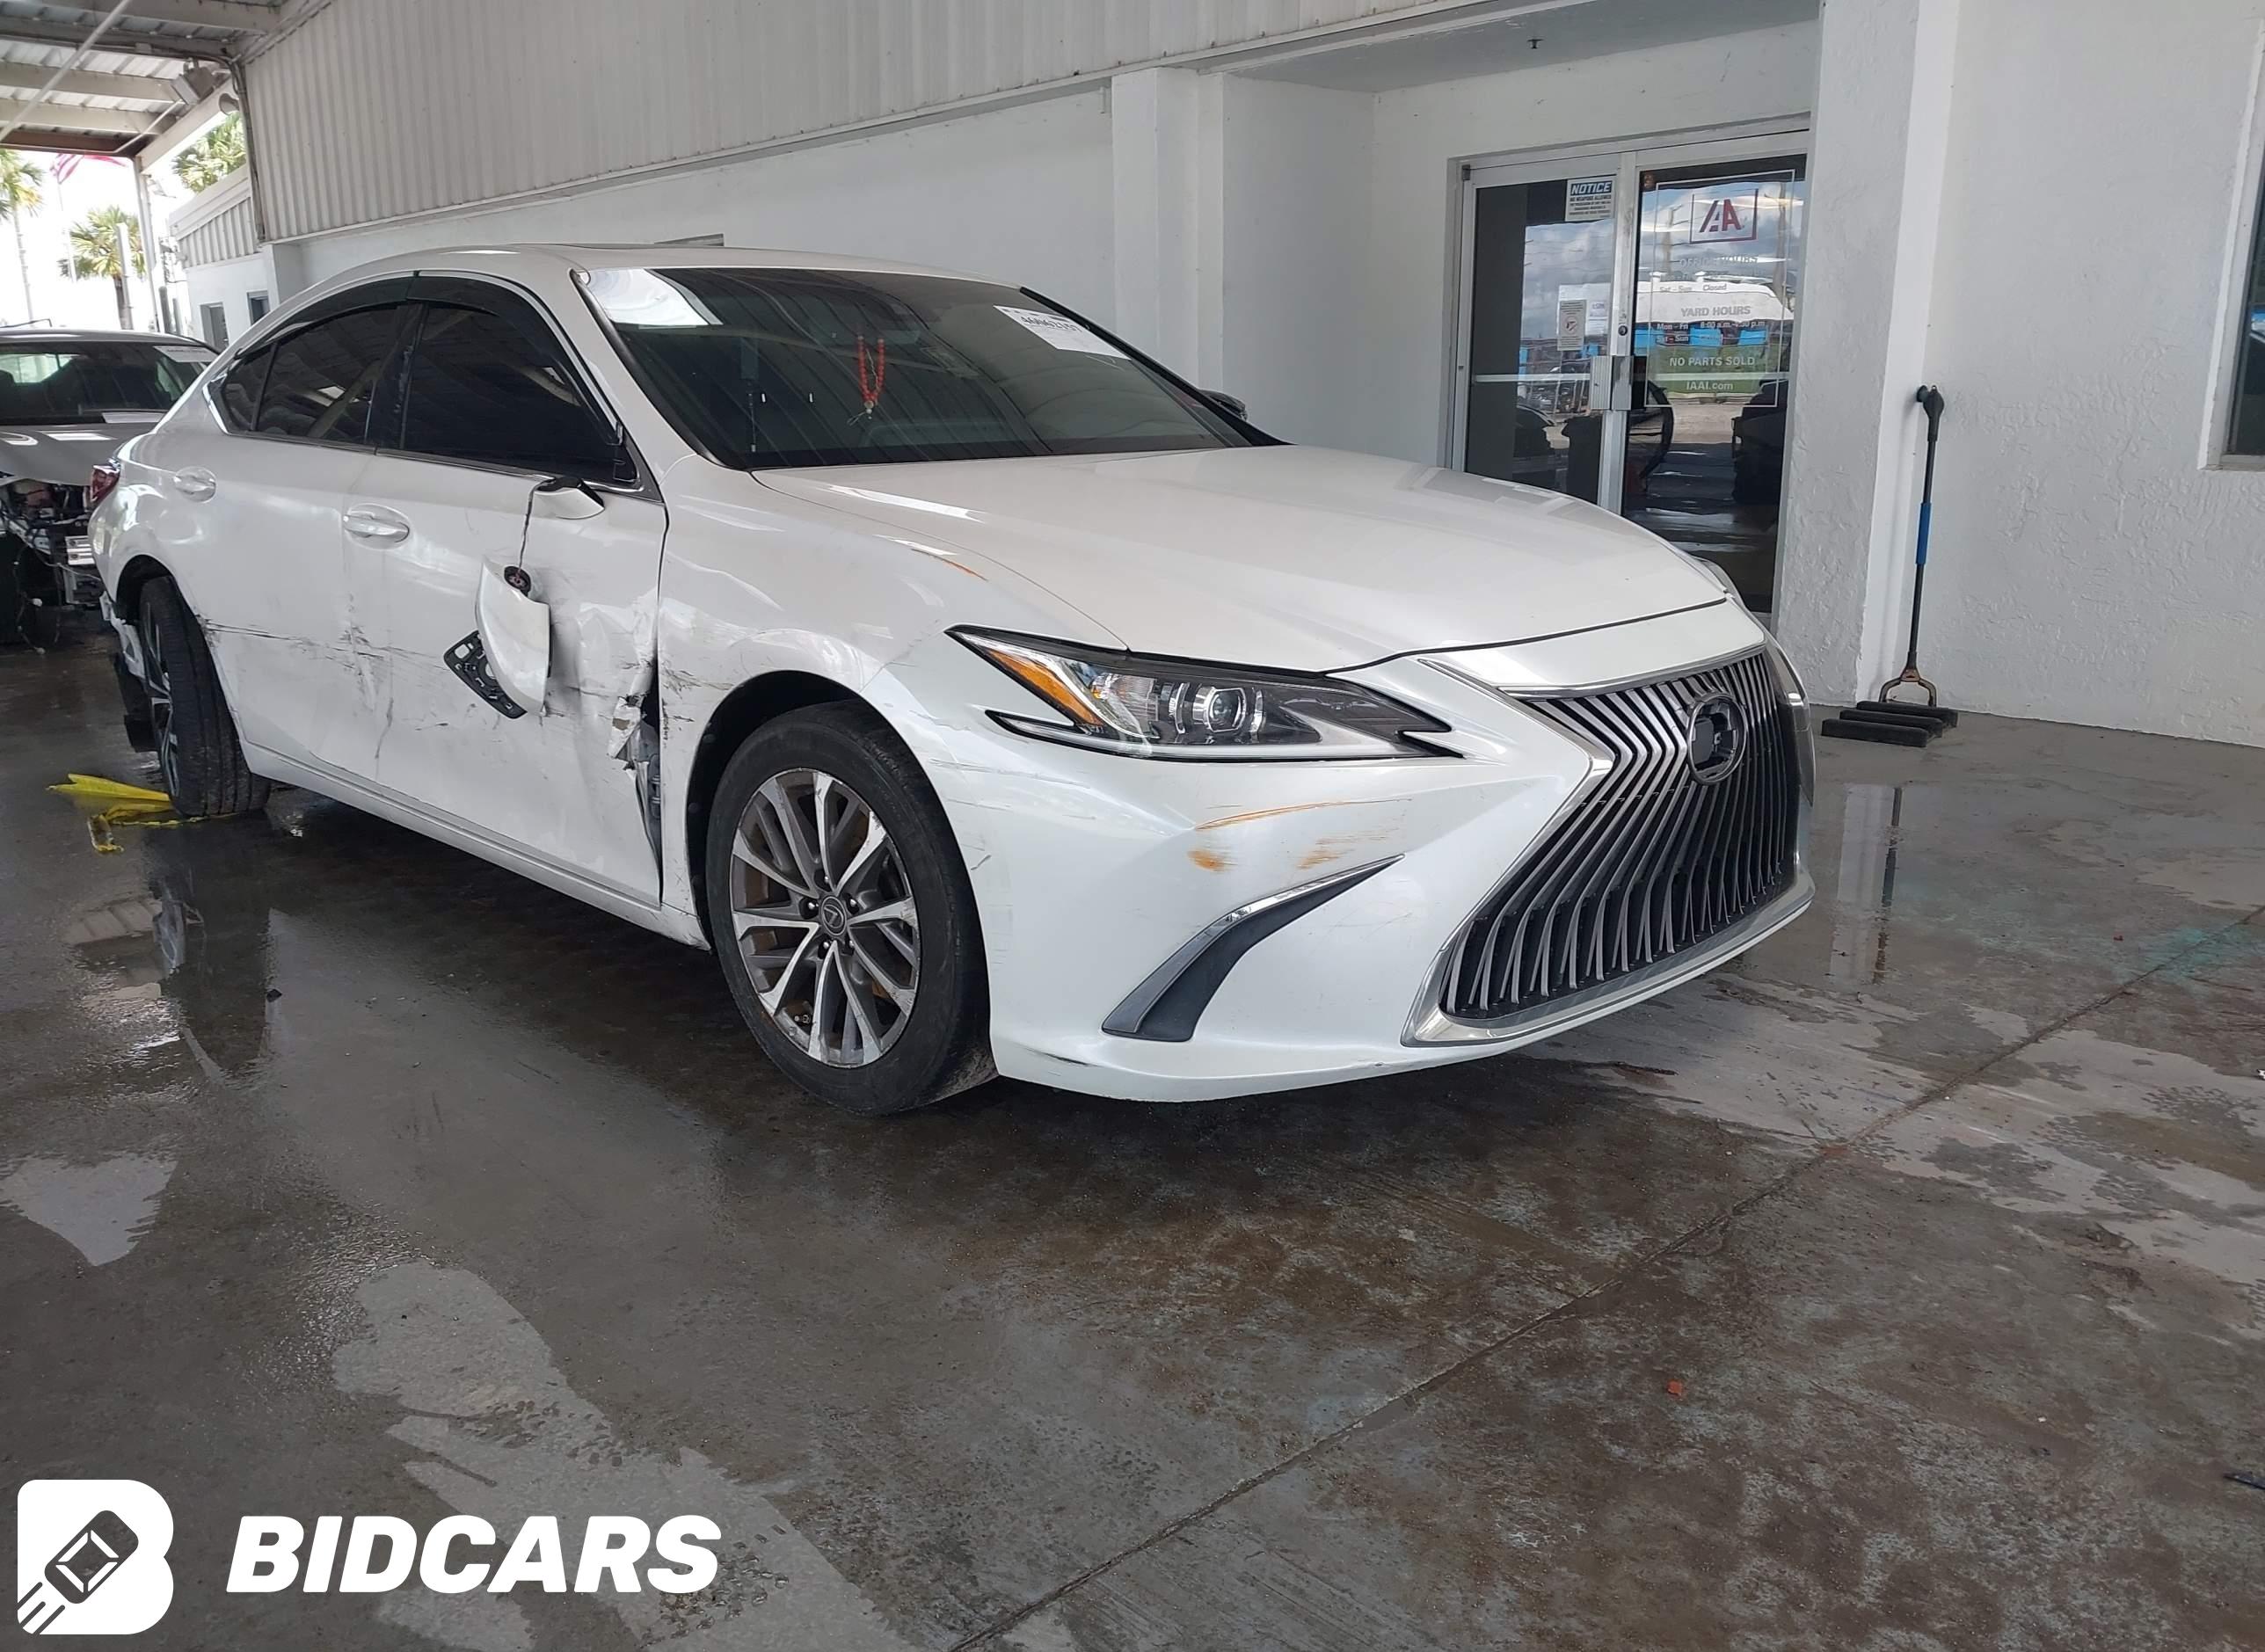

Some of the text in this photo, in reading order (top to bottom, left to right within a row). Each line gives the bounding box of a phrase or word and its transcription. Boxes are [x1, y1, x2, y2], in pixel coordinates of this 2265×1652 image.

[1571, 182, 1612, 194] NOTICE
[1681, 306, 1751, 317] YARD HOURS
[1670, 356, 1755, 367] NO PARTS SOLD
[1686, 381, 1734, 390] IAAI.com
